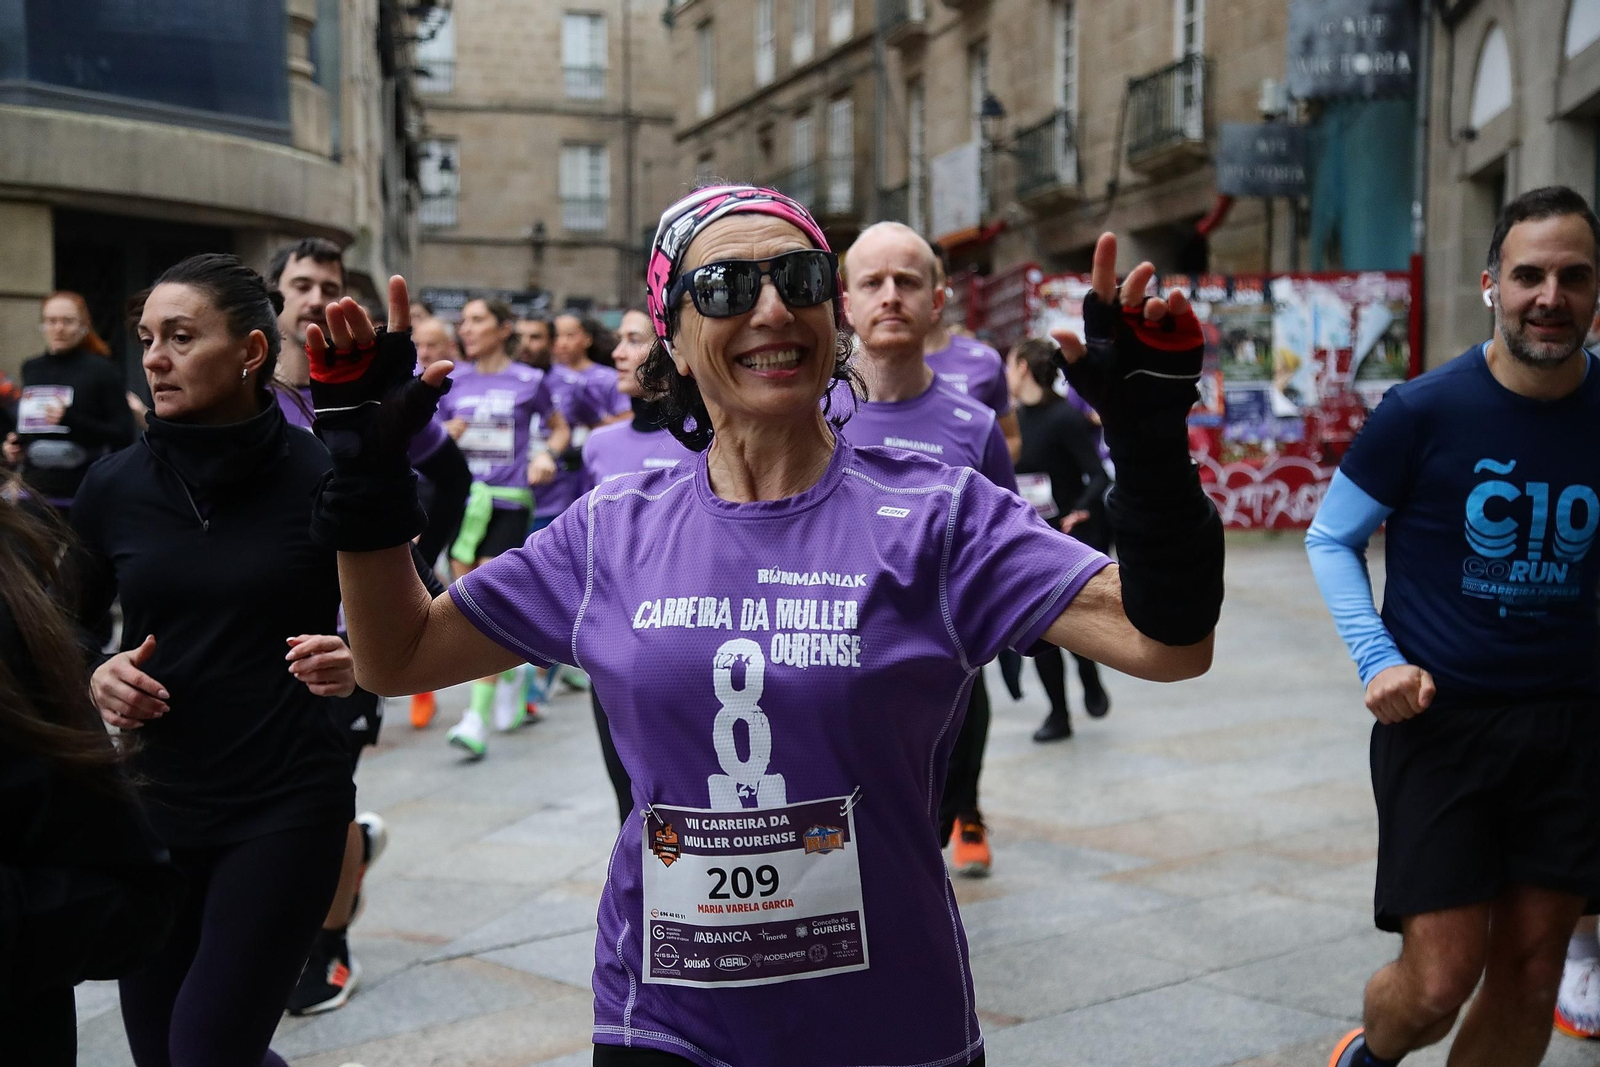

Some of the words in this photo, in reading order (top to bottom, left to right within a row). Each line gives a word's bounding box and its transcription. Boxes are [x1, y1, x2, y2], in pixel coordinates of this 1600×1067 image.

[633, 596, 733, 631] CARREIRA
[740, 598, 770, 631] DA
[776, 598, 858, 632] MULLER
[771, 633, 862, 669] OURENSE
[684, 817, 699, 830] VII
[701, 815, 767, 831] CARREIRA
[769, 814, 791, 827] DA
[683, 834, 731, 849] MULLER
[732, 833, 797, 849] OURENSE
[706, 864, 780, 900] 209
[697, 903, 725, 914] MARIA
[726, 901, 760, 913] VARELA
[762, 899, 794, 911] GARCIA
[811, 918, 840, 927] Concello
[813, 922, 856, 936] OURENSE
[719, 957, 748, 968] ABRIL
[763, 950, 807, 962] AODEMPER
